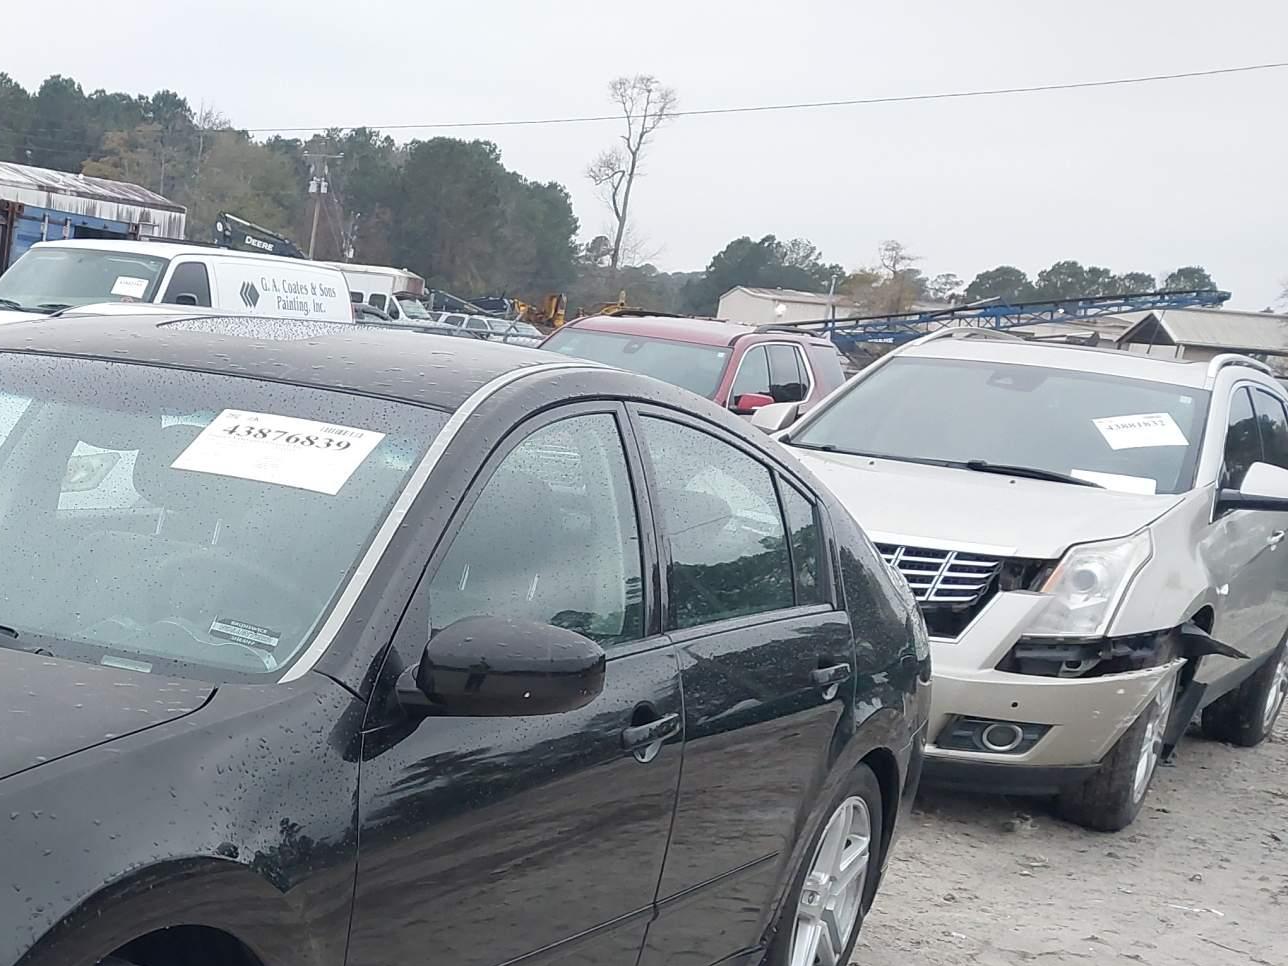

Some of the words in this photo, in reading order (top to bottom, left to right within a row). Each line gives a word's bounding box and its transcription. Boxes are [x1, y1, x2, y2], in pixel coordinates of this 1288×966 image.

[245, 236, 274, 251] DEERE
[310, 282, 318, 297] &
[319, 283, 337, 298] Sons
[312, 299, 327, 313] Inc.
[223, 425, 351, 451] 43876839
